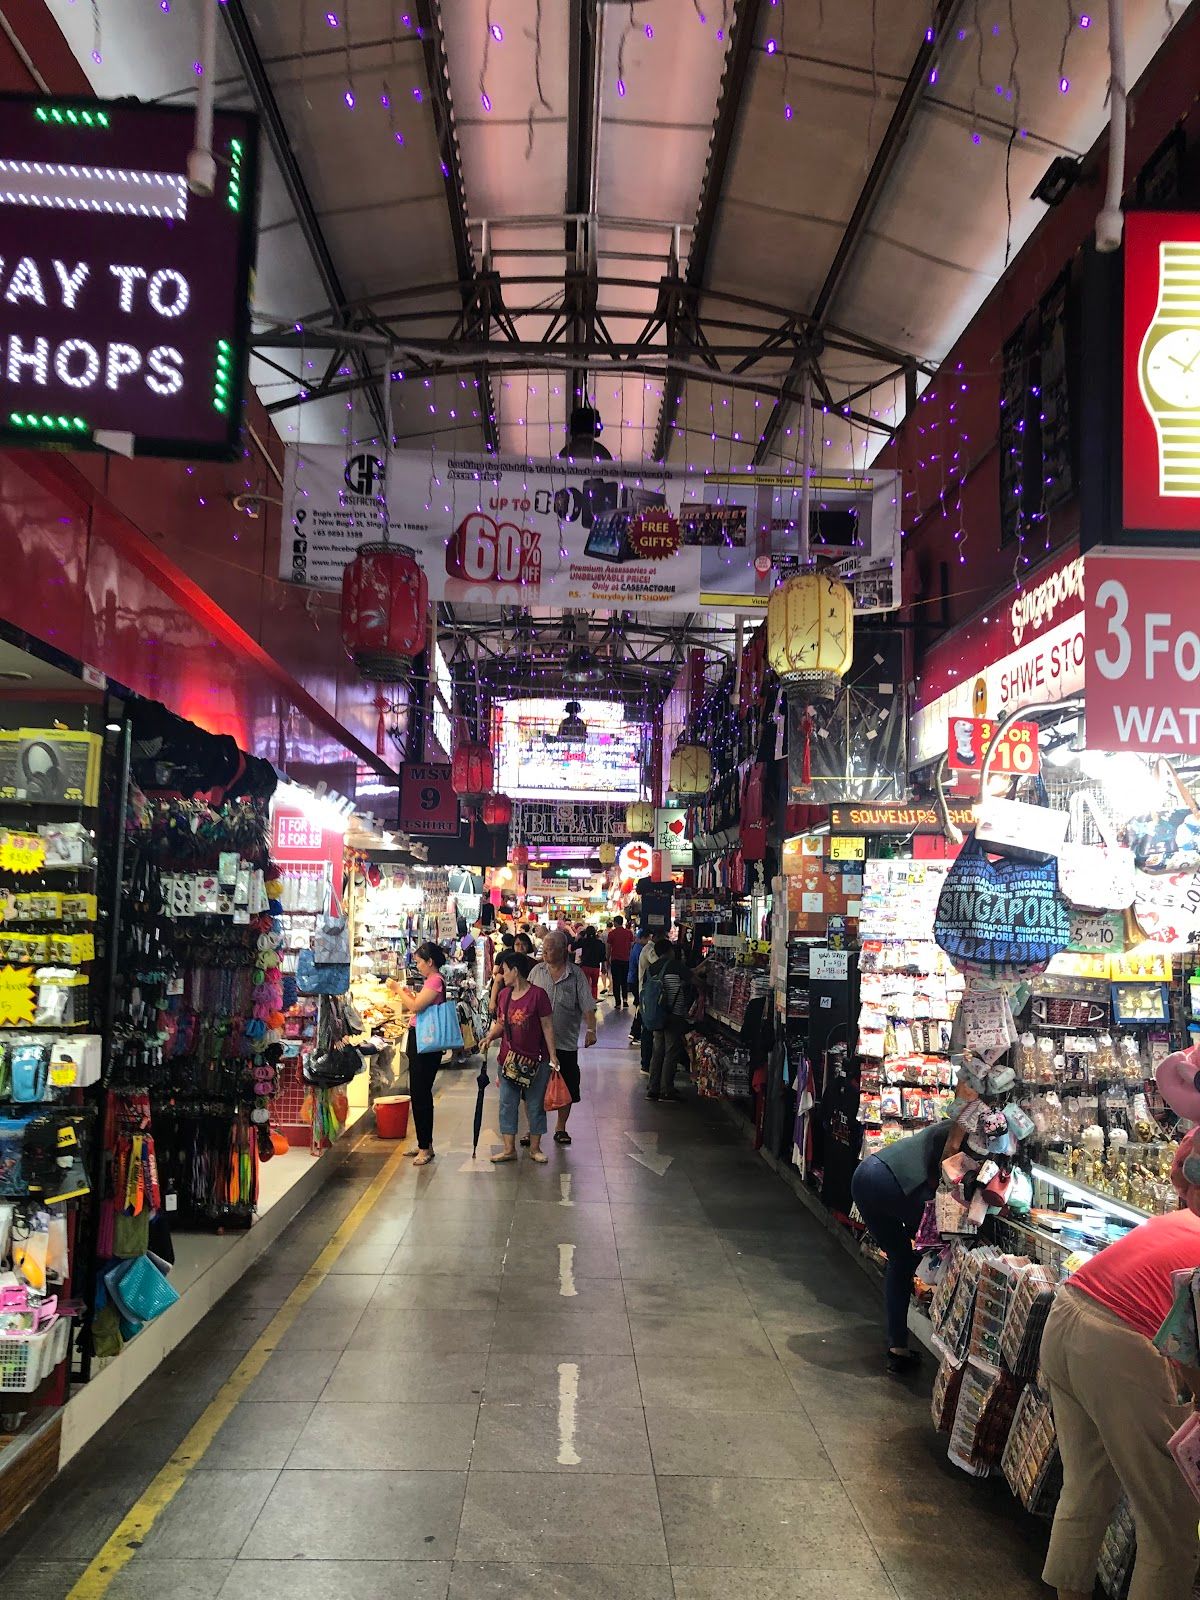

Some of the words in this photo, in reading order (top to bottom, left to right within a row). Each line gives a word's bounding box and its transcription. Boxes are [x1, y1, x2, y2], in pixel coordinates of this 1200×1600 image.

[0, 256, 90, 310] AY
[109, 263, 190, 317] TO
[3, 335, 184, 395] HOPS
[489, 497, 508, 510] UP
[512, 498, 531, 512] TO
[642, 522, 669, 533] FREE
[640, 537, 673, 547] GIFTS
[570, 564, 604, 573] Premium
[605, 565, 647, 574] Accessories
[570, 572, 624, 583] UNBELIEVABLE
[592, 582, 609, 592] Only
[620, 584, 676, 593] CASEFACTORIE
[1095, 579, 1132, 680] 3
[1001, 653, 1045, 703] SHWE
[981, 723, 990, 739] 3
[563, 751, 587, 762] food
[421, 788, 440, 810] 9
[850, 810, 938, 824] SOUVENIRS
[949, 810, 982, 824] SHO
[281, 819, 286, 831] 1
[289, 819, 308, 832] FOR
[404, 820, 453, 831] T-SHIRT
[664, 821, 669, 834] I
[280, 833, 286, 845] 2
[288, 833, 307, 845] FOR
[532, 835, 551, 843] MOBILE
[552, 835, 568, 843] PHONE
[627, 845, 649, 872] $
[833, 848, 840, 857] 5
[855, 848, 864, 858] 10
[939, 892, 1071, 929] SINGAPORE
[972, 922, 1012, 933] SINGAPORE
[1015, 926, 1055, 936] SINGAPORE
[1078, 919, 1110, 927] OFFER
[965, 930, 1015, 942] SINGAPORE
[1017, 934, 1070, 946] SINGAPORE
[1100, 928, 1114, 944] 10
[751, 940, 758, 951] 3
[737, 952, 745, 963] 3
